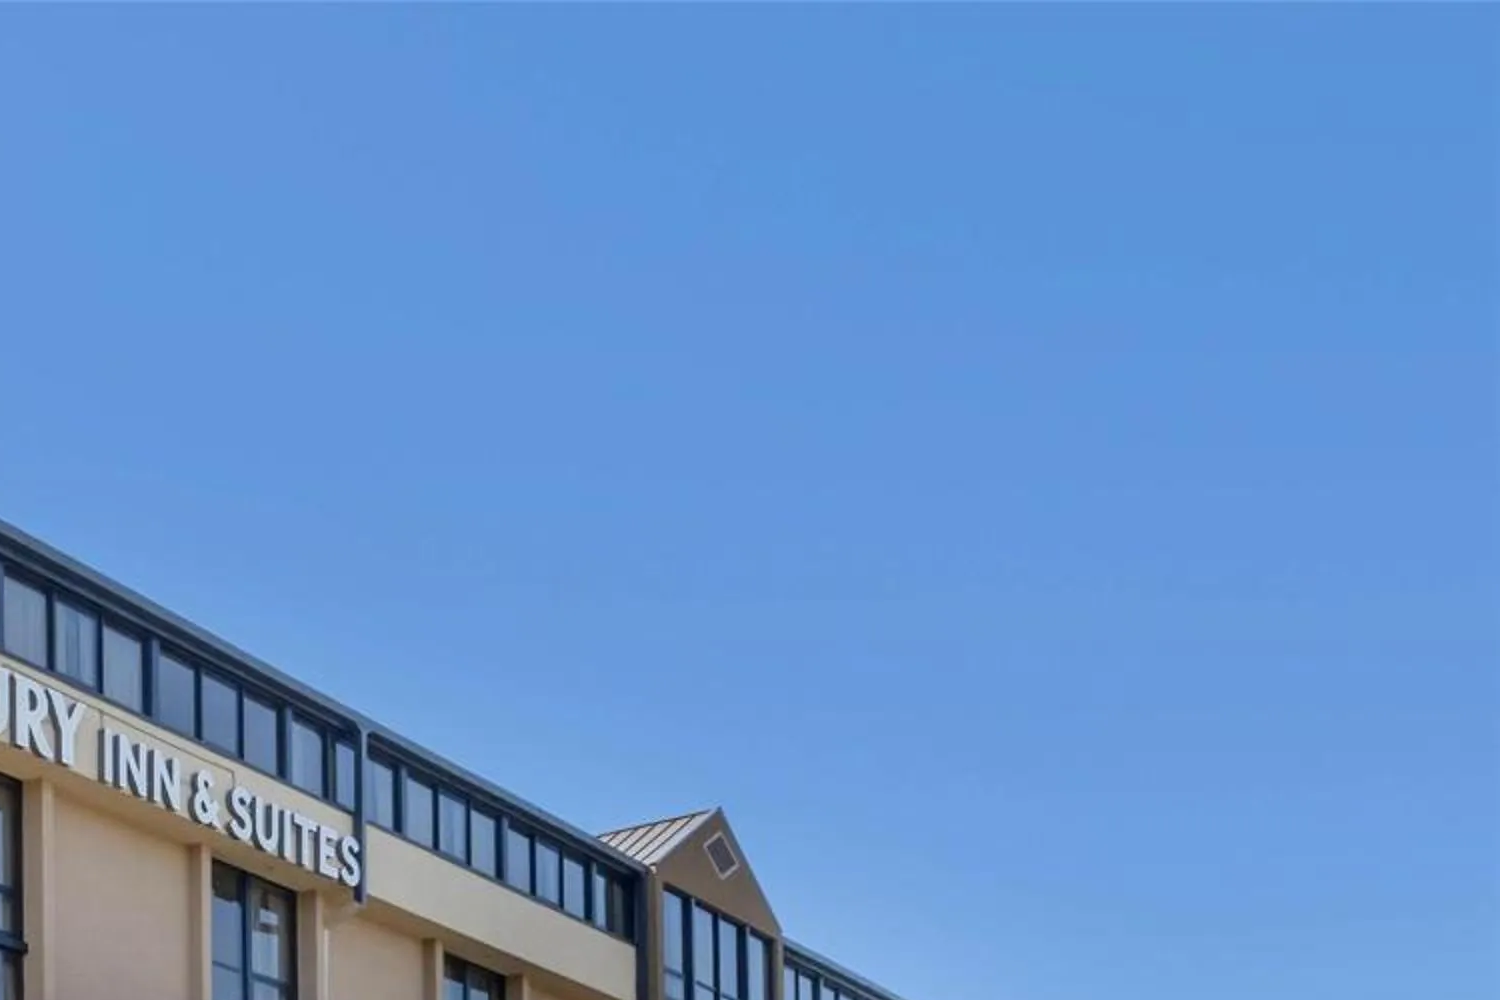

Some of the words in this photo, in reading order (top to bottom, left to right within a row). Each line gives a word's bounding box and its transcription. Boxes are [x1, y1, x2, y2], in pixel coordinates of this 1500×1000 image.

[100, 727, 181, 812] INN
[193, 771, 220, 830] &
[230, 785, 362, 888] SUITES
